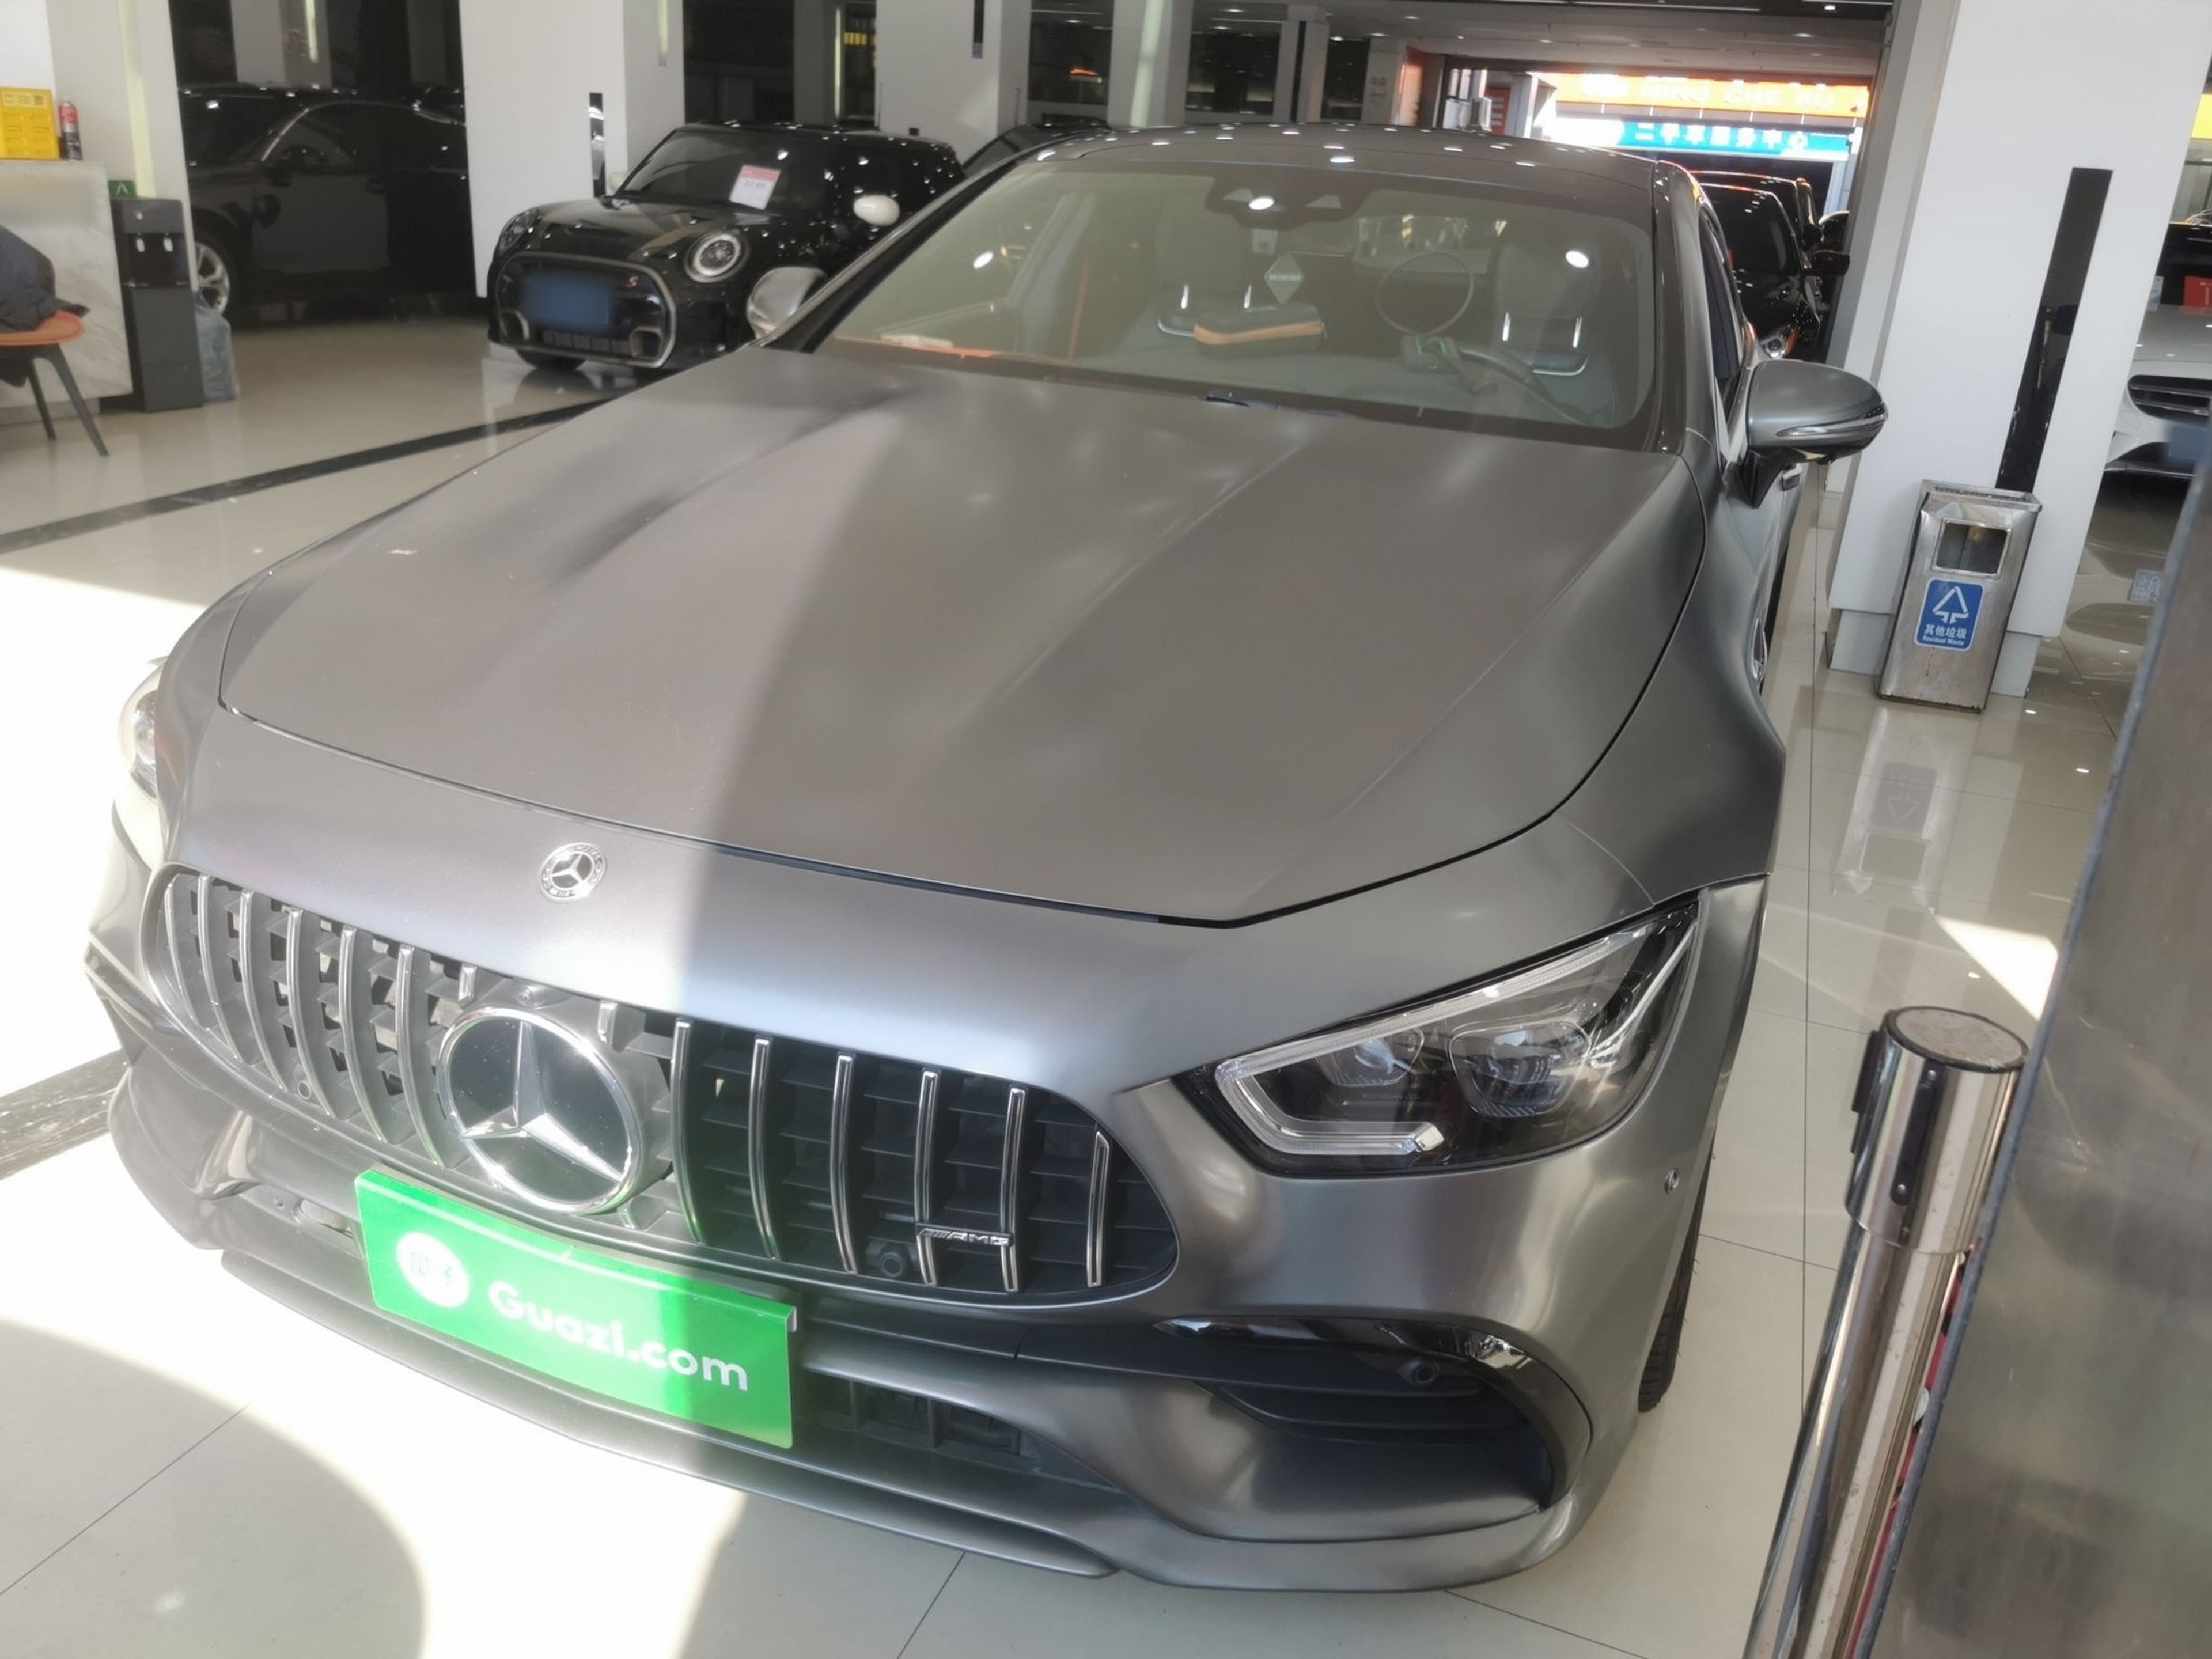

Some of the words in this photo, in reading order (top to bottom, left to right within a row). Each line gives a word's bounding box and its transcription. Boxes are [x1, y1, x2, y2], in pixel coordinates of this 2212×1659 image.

[1796, 90, 1834, 109] KU
[1924, 624, 1967, 639] 其他垃圾
[946, 1232, 1010, 1247] AMG
[488, 1281, 749, 1392] Guazi.com
